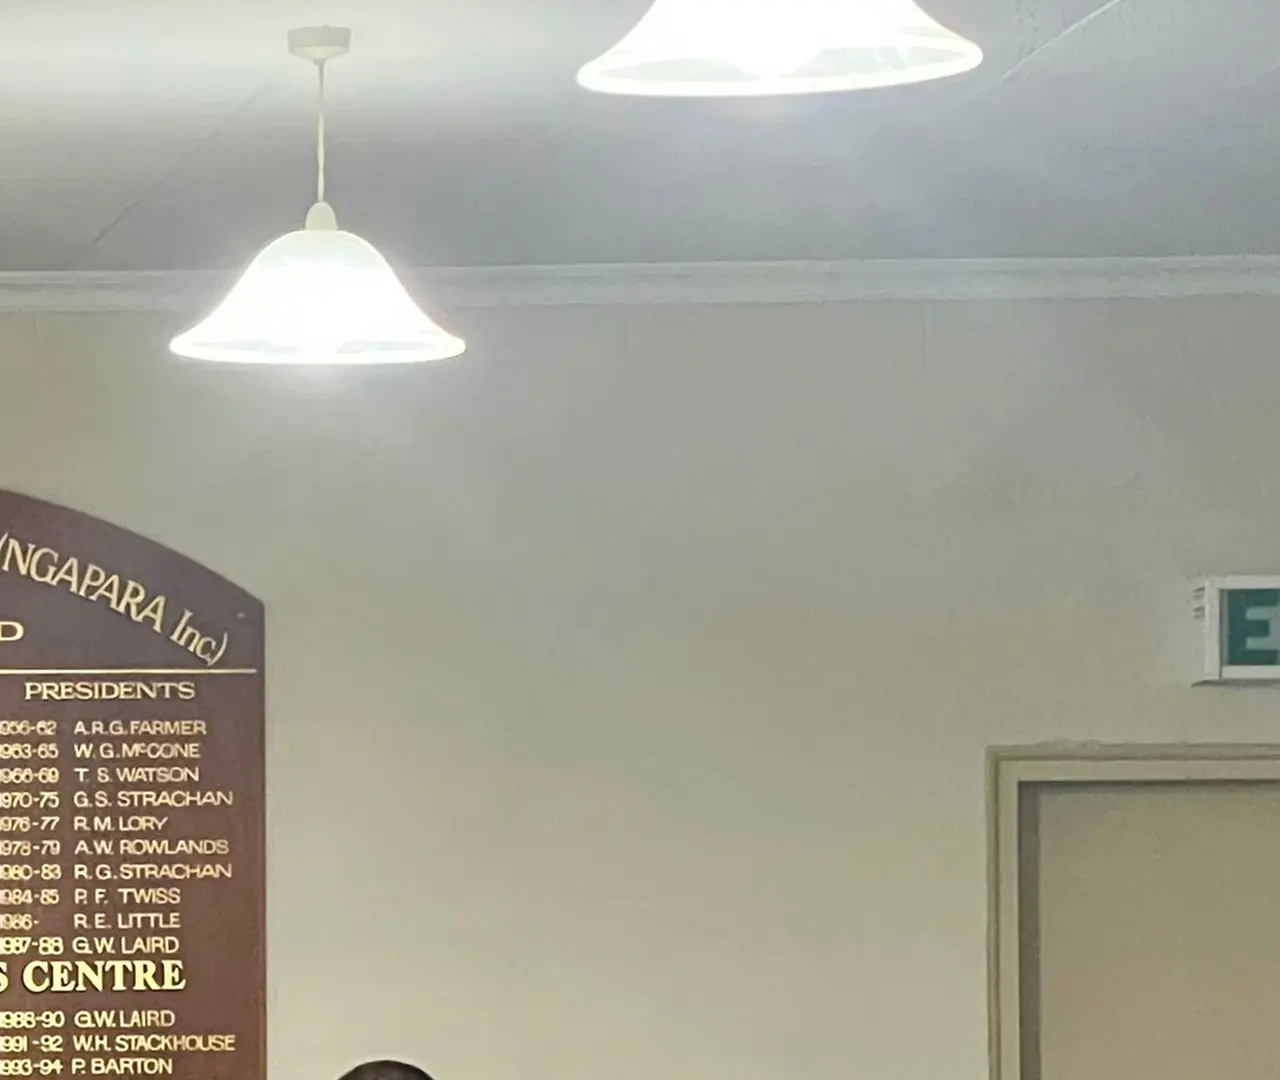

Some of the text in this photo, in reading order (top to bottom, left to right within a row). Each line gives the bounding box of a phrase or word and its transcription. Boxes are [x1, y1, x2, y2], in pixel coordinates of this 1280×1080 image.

[24, 681, 196, 701] PRESIDENTS
[115, 766, 200, 784] WATSON
[116, 789, 234, 809] STRACHAN
[118, 815, 169, 833] LORY
[119, 838, 230, 857] ROWLANDS
[116, 887, 181, 906] TWISS
[117, 912, 182, 931] LITTLE
[120, 935, 180, 956] LAIRD
[22, 959, 187, 993] CENTRE
[118, 1009, 176, 1029] LAIRD
[114, 1033, 236, 1053] STACKHOUSE
[90, 1057, 173, 1076] BARTON
